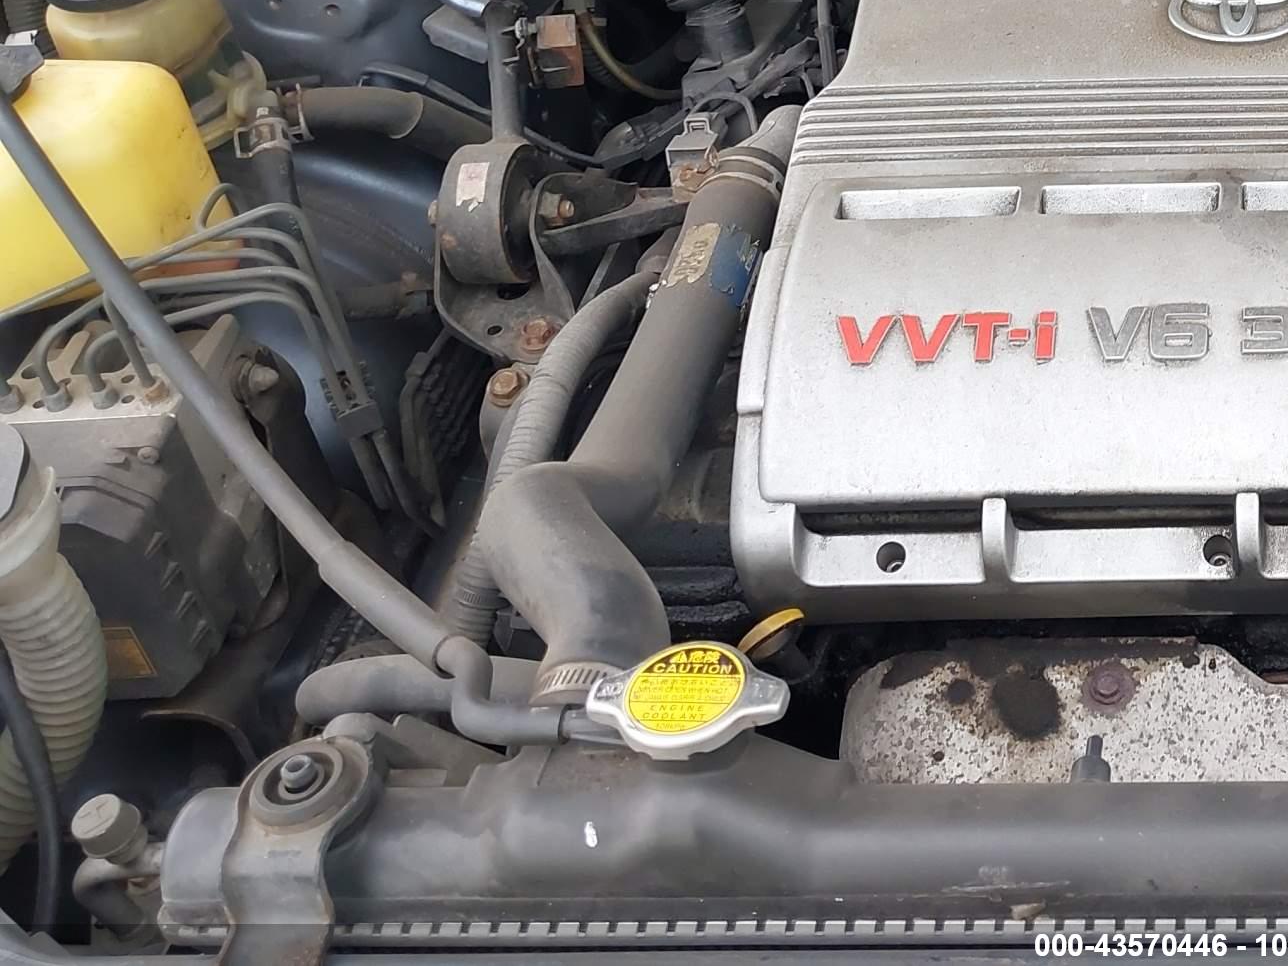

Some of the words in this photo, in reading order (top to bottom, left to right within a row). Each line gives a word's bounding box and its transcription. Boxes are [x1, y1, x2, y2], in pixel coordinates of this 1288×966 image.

[836, 310, 1059, 366] VVT-i
[1086, 302, 1211, 363] V6
[652, 662, 733, 675] CAUTION
[650, 703, 705, 712] ENGINE
[642, 712, 706, 721] COOLANT
